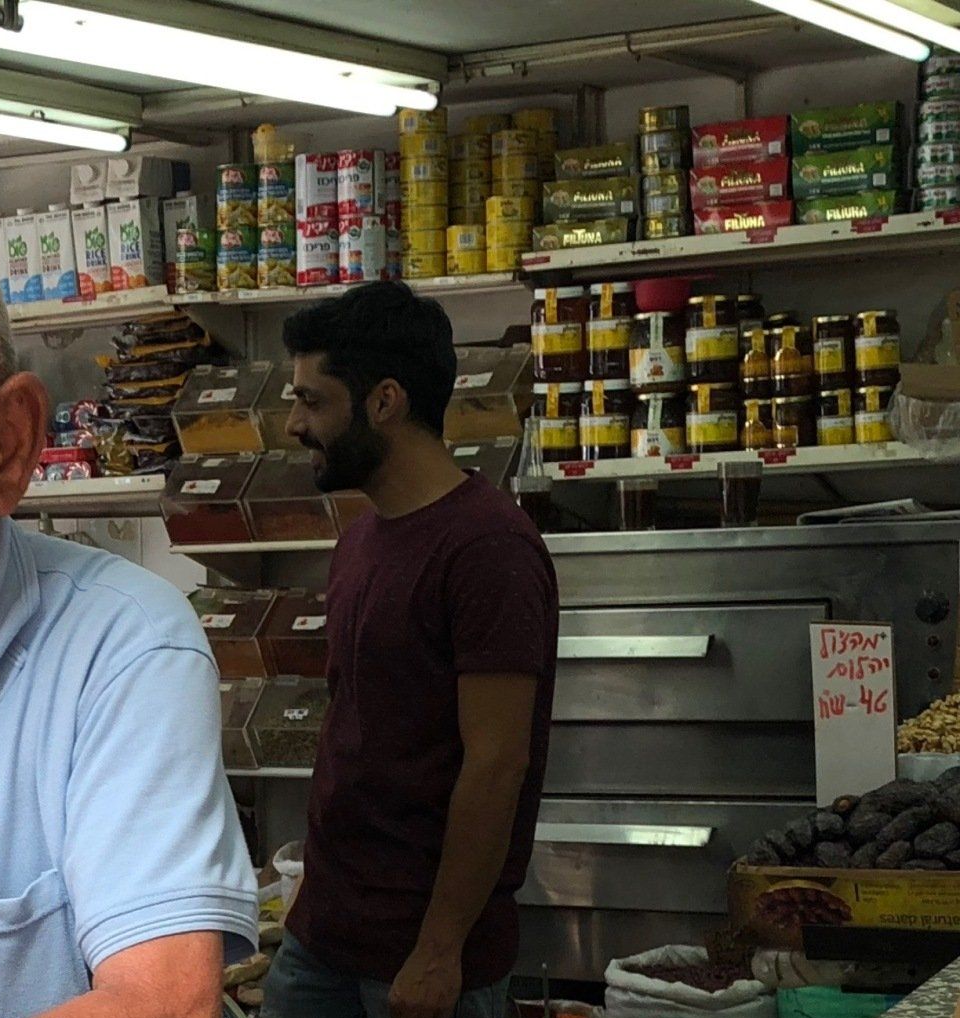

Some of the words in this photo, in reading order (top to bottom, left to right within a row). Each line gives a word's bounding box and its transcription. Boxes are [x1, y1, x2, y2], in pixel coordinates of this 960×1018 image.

[120, 242, 140, 253] RICE
[86, 249, 106, 260] RICE
[859, 684, 888, 714] 46
